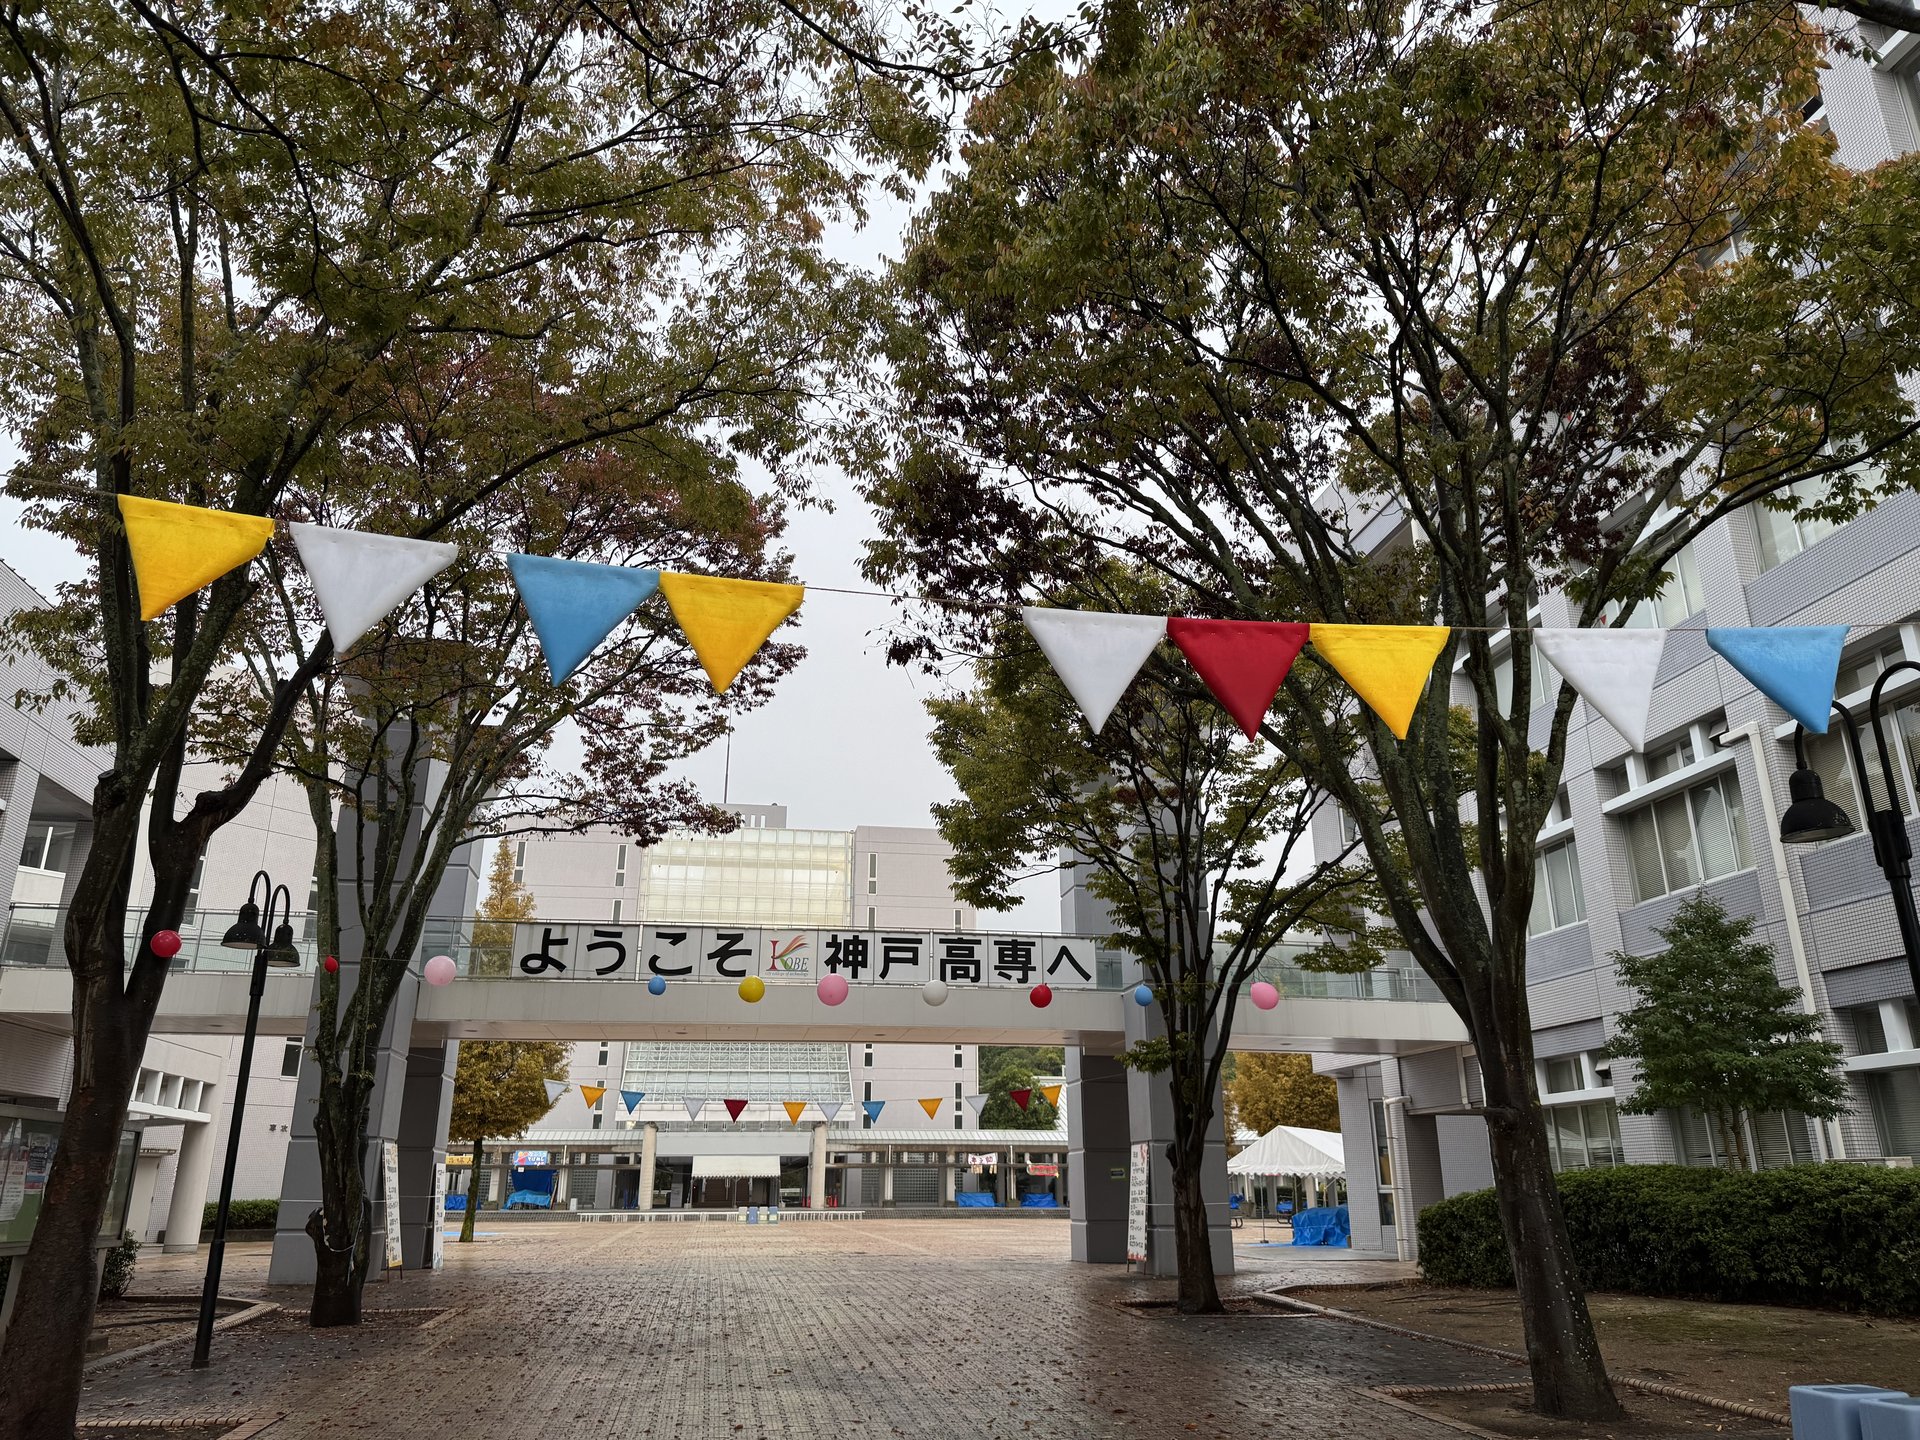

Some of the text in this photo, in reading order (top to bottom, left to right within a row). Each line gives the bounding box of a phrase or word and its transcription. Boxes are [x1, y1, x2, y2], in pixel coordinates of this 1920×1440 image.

[520, 928, 1092, 983] ようこそ 神戸高専へ
[768, 934, 809, 971] KOBE
